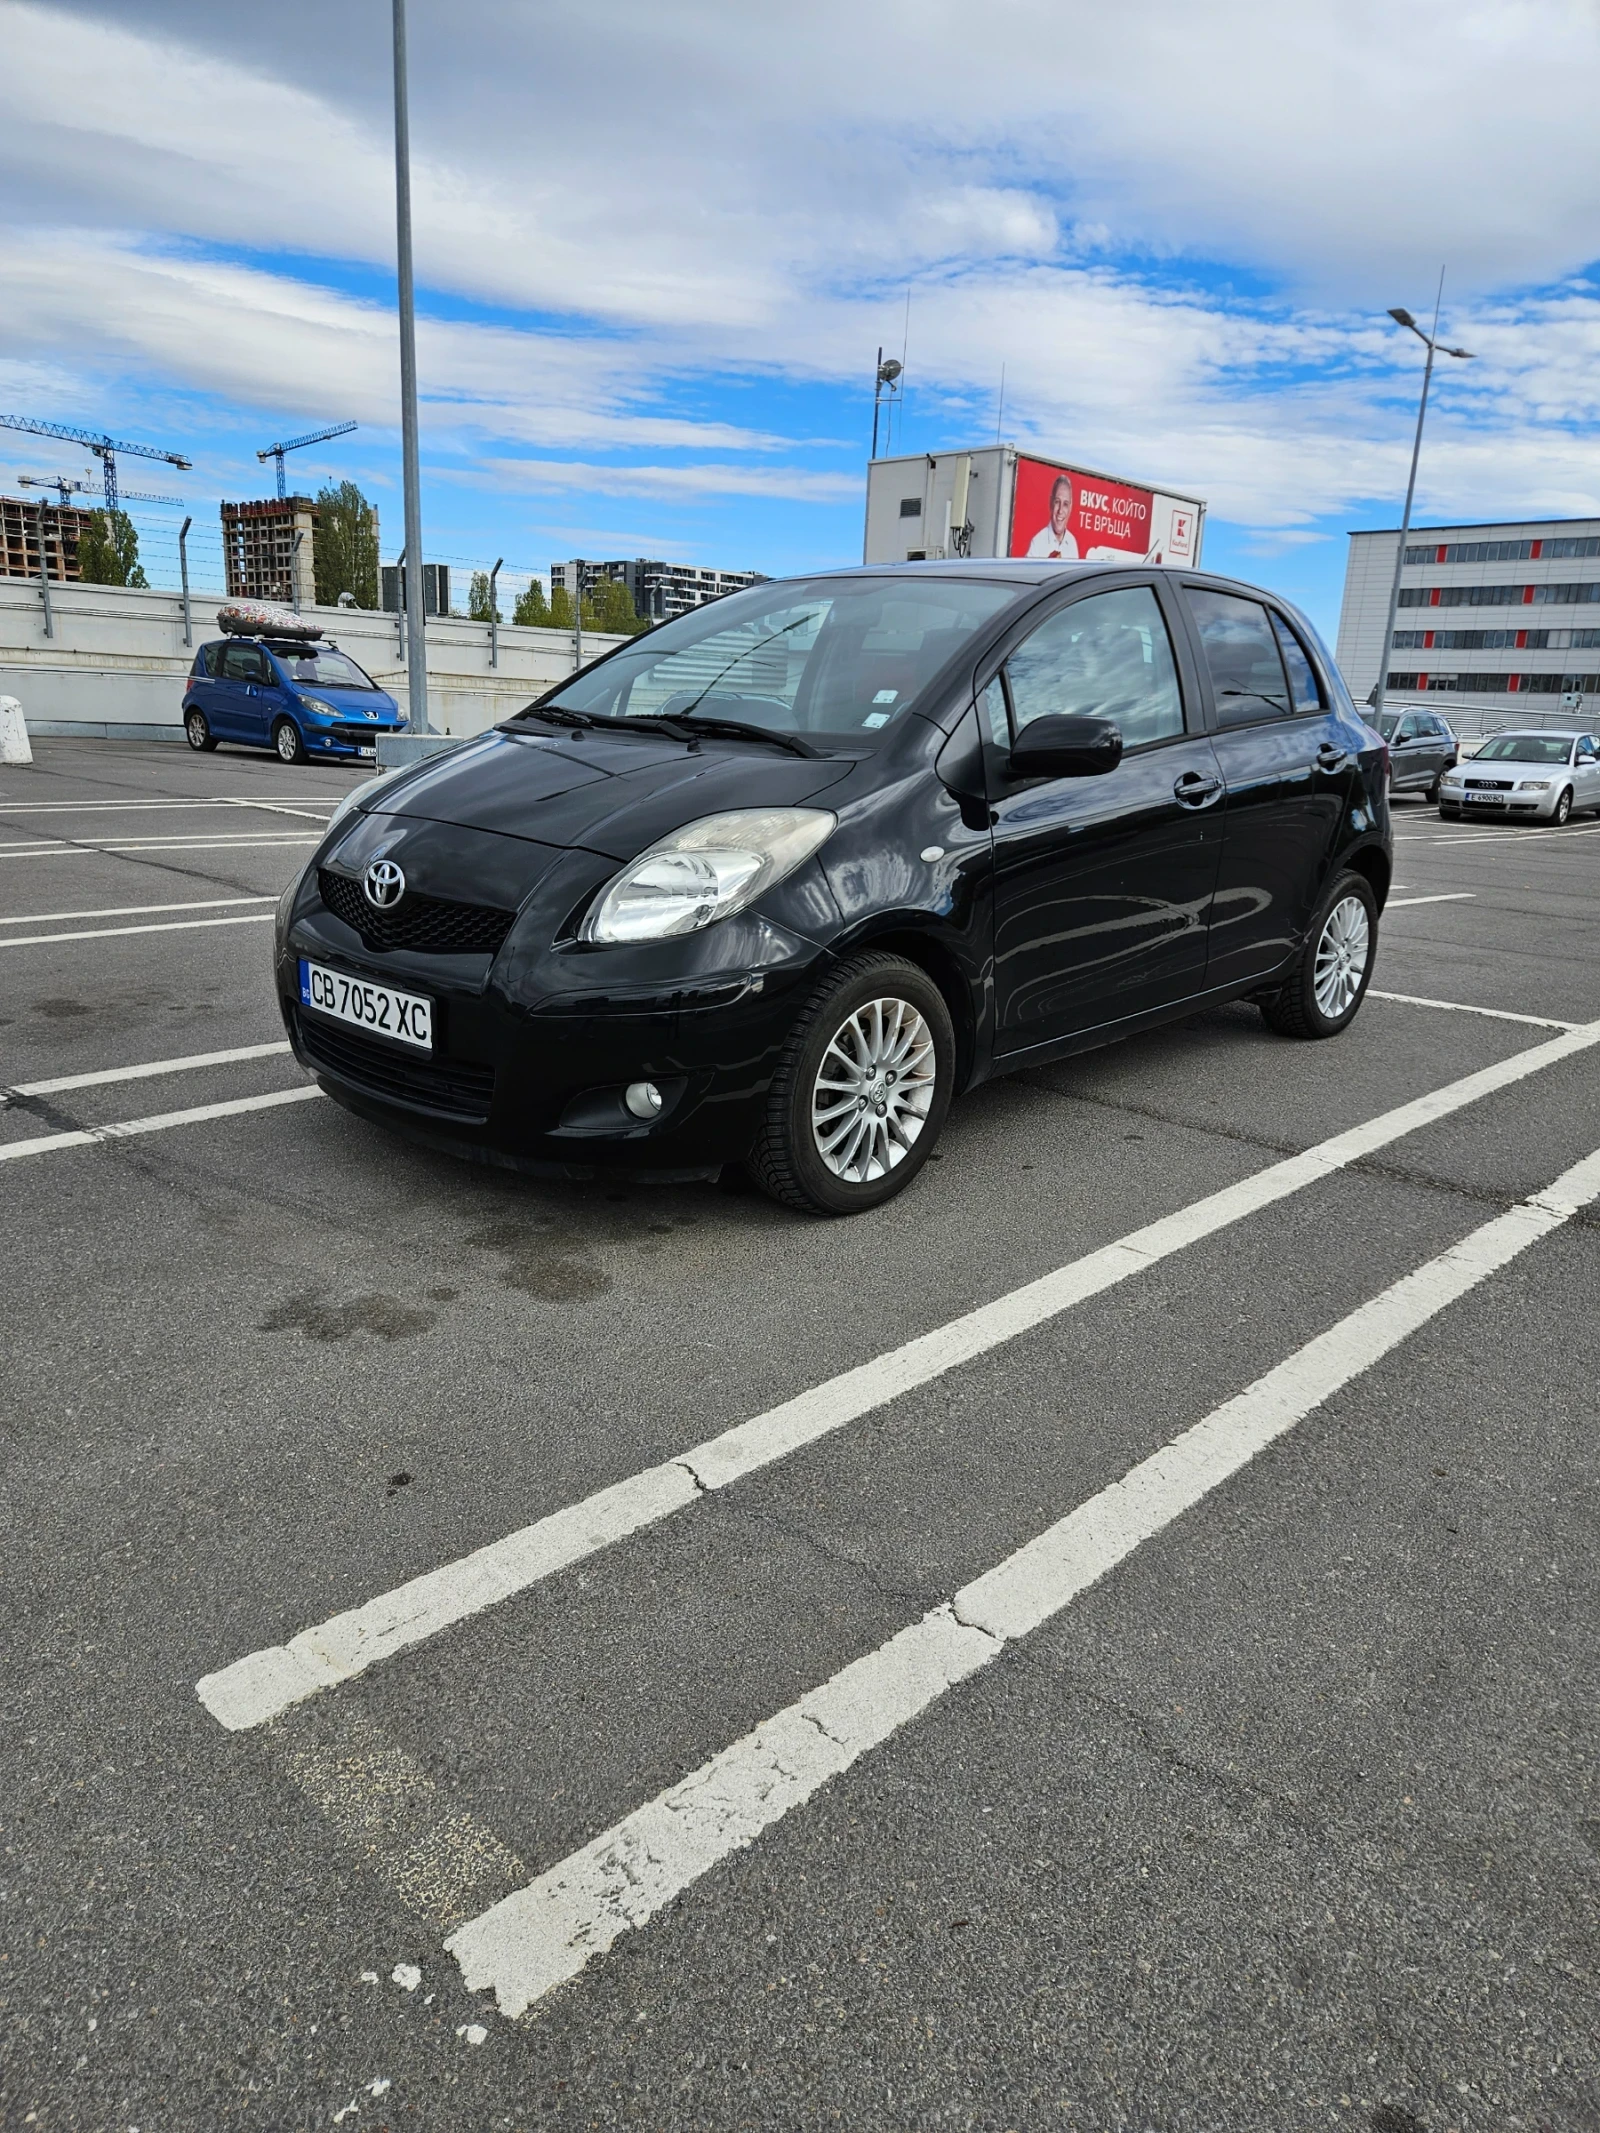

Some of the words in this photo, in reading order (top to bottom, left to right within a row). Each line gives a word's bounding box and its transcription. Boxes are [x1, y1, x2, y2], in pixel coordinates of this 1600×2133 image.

[1080, 489, 1110, 514] ВКУС,
[1112, 497, 1147, 520] КОЙТО
[1079, 511, 1092, 530] ТЕ
[1093, 514, 1131, 540] ВРЪЩА
